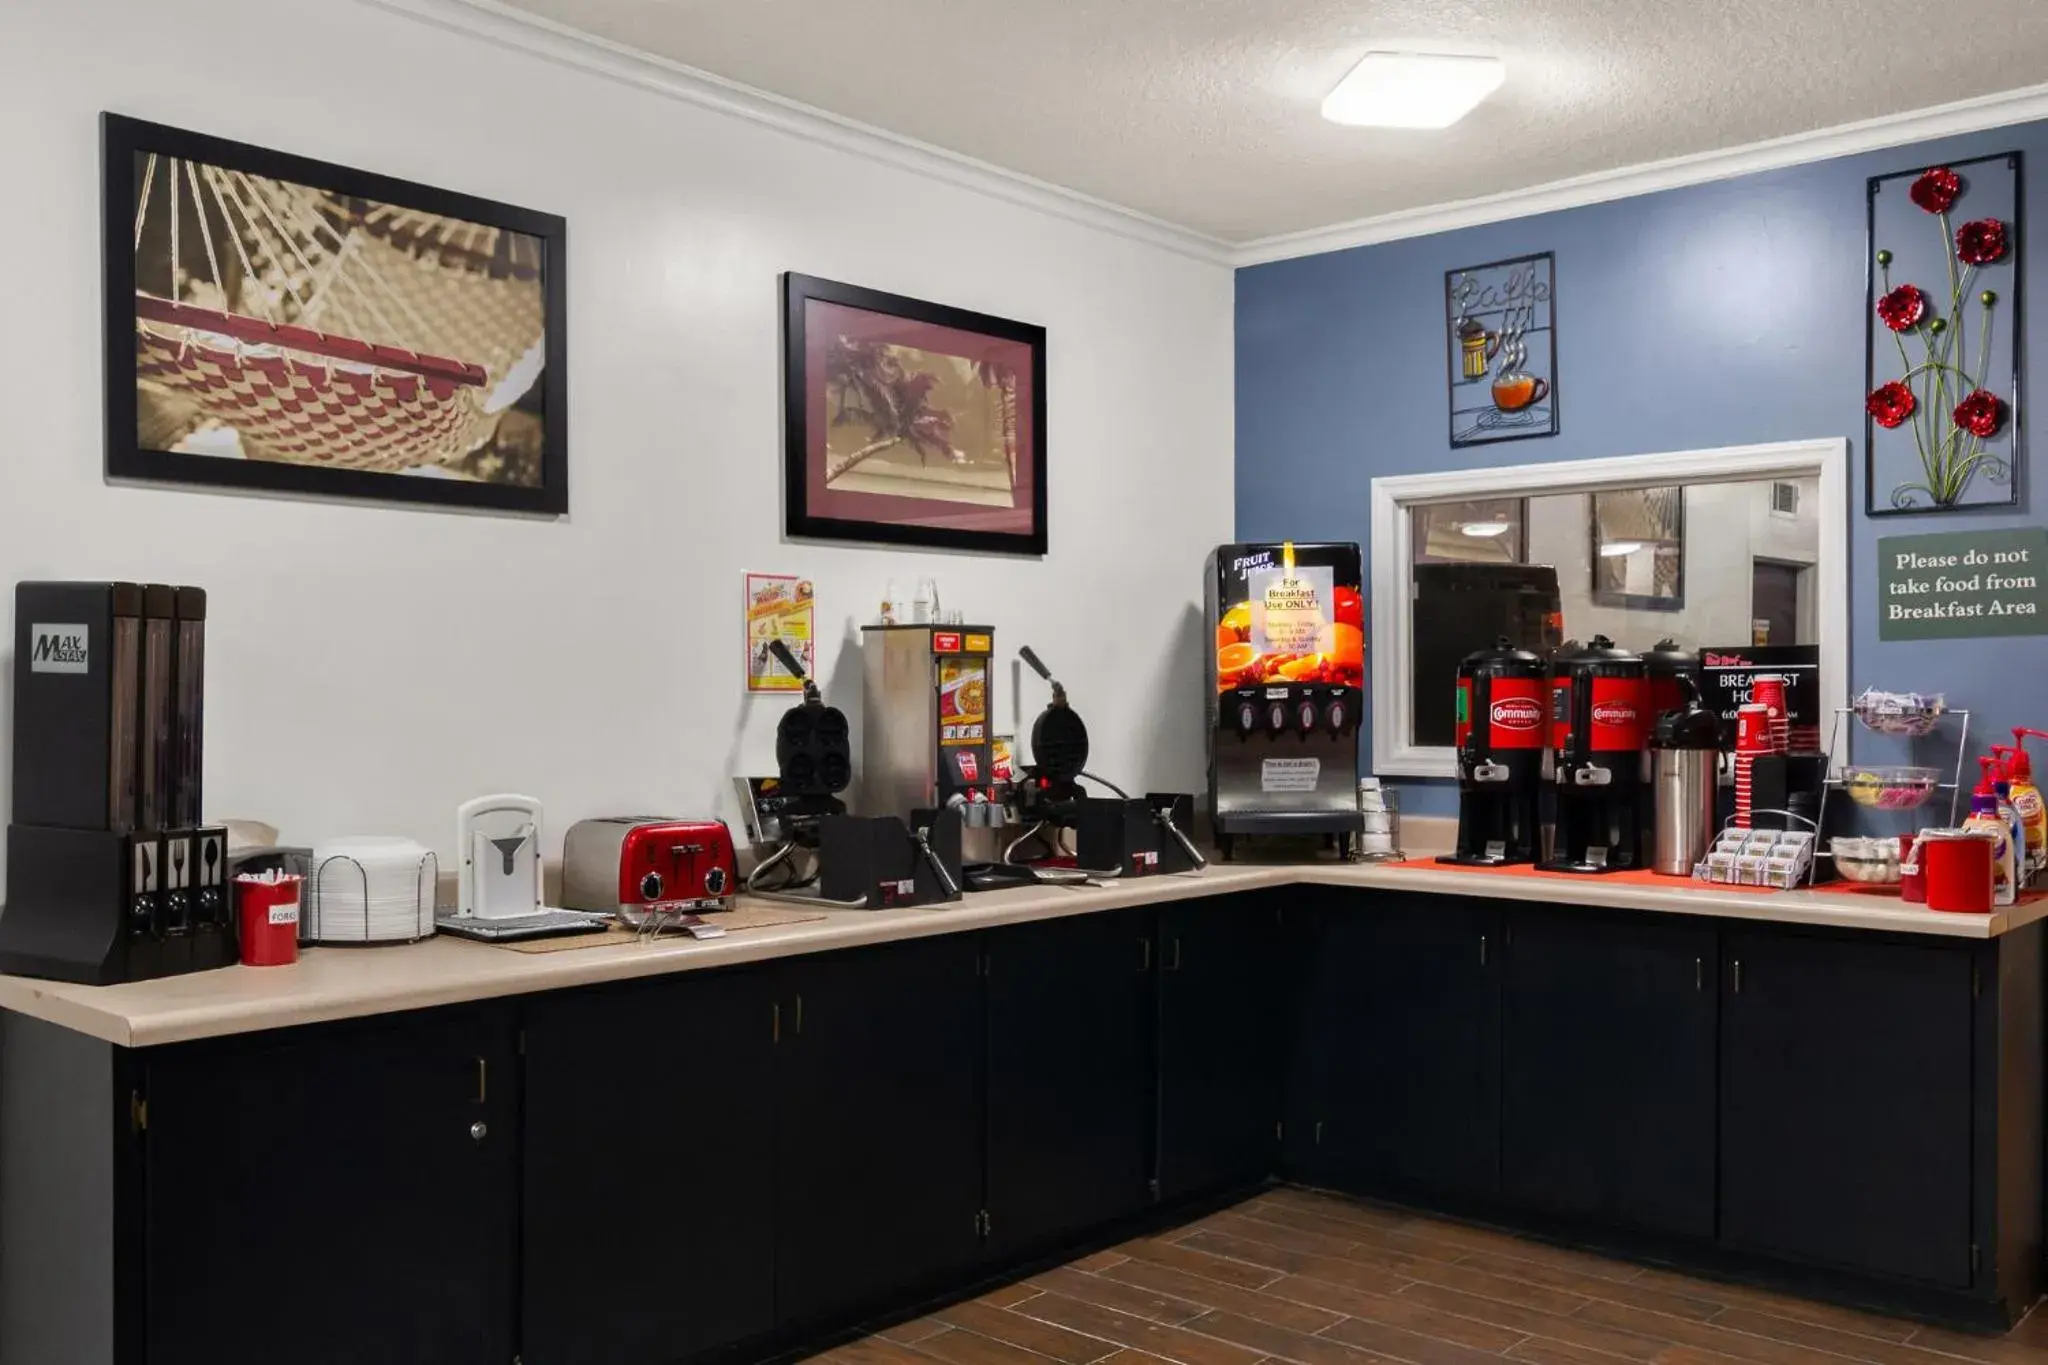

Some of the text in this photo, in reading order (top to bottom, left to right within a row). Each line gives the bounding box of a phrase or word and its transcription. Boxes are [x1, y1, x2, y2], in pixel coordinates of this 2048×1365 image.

[1233, 551, 1270, 572] FRUIT
[1895, 548, 2029, 570] Please do not
[1282, 578, 1299, 586] For
[1889, 573, 2037, 595] take food from
[1268, 589, 1315, 598] Breakfast
[1265, 600, 1283, 608] Use
[1888, 599, 2037, 620] Breakfast Area
[1719, 673, 1800, 688] BREAST
[1493, 706, 1541, 722] Community
